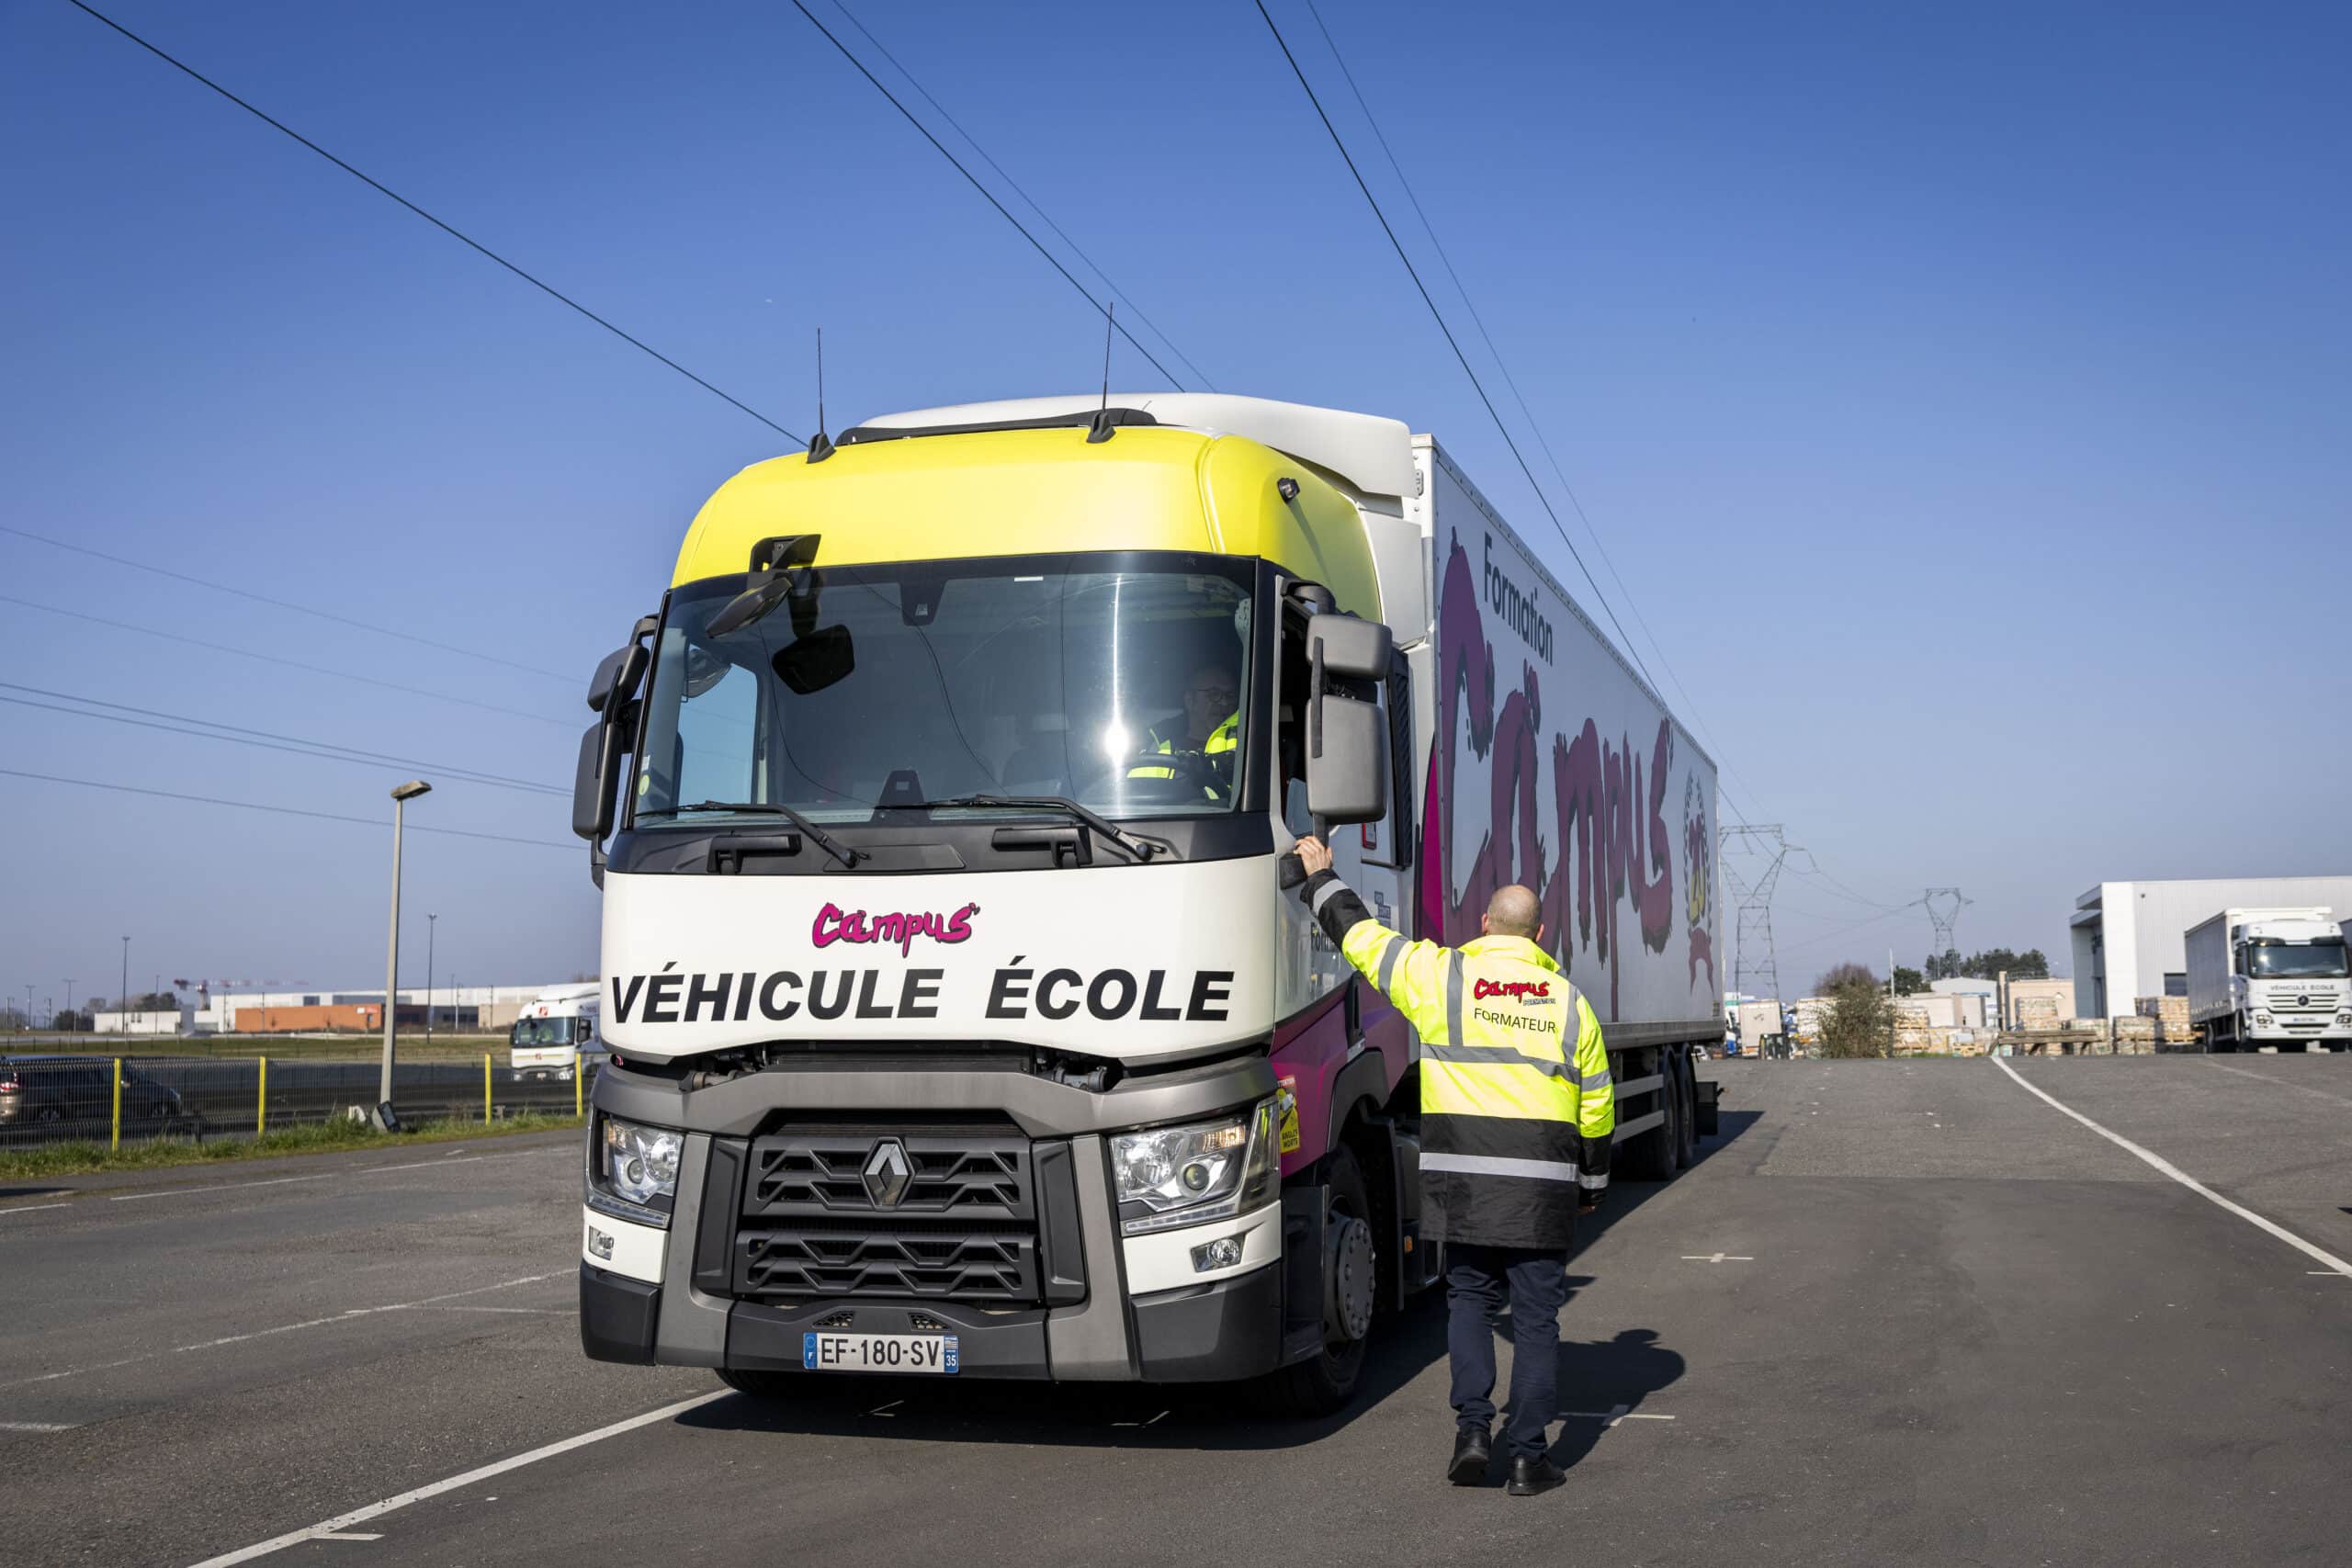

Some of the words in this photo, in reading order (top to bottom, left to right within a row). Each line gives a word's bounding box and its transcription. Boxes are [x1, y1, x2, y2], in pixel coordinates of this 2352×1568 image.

[1485, 530, 1553, 667] Formation
[812, 902, 980, 957] Campus
[612, 961, 944, 1023] VÉHICULE
[986, 955, 1234, 1021] ÉCOLE
[1474, 978, 1550, 1003] Campus
[1474, 1008, 1555, 1033] FORMATEUR
[808, 1351, 814, 1359] F
[821, 1338, 939, 1366] EF-180-SV
[946, 1355, 956, 1366] 35
